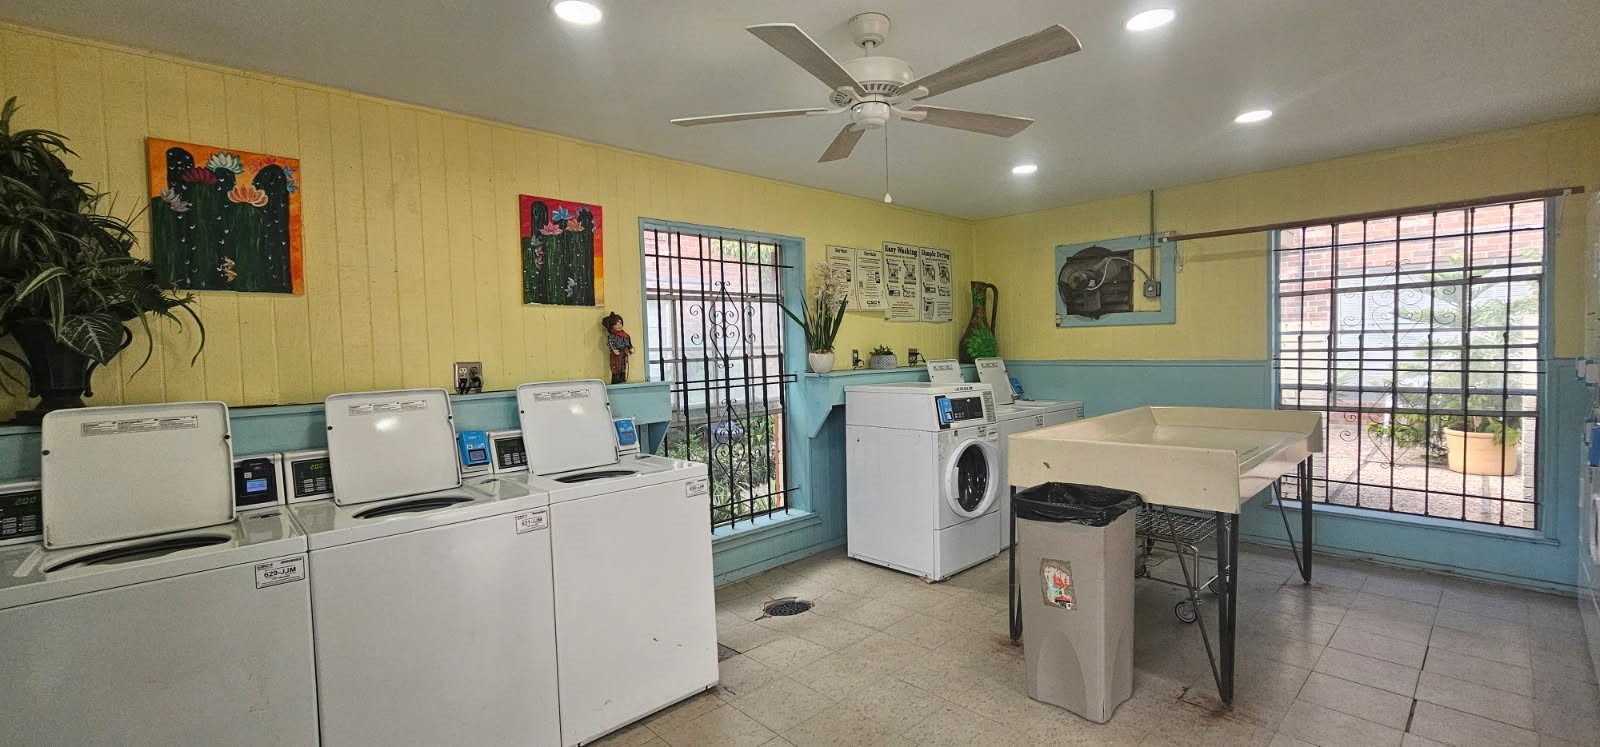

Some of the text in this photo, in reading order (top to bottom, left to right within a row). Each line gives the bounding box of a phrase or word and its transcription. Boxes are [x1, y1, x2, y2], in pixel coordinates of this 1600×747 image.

[885, 245, 896, 253] Easy
[897, 247, 918, 257] Washing
[921, 250, 936, 258] Simple
[937, 252, 950, 260] Drying
